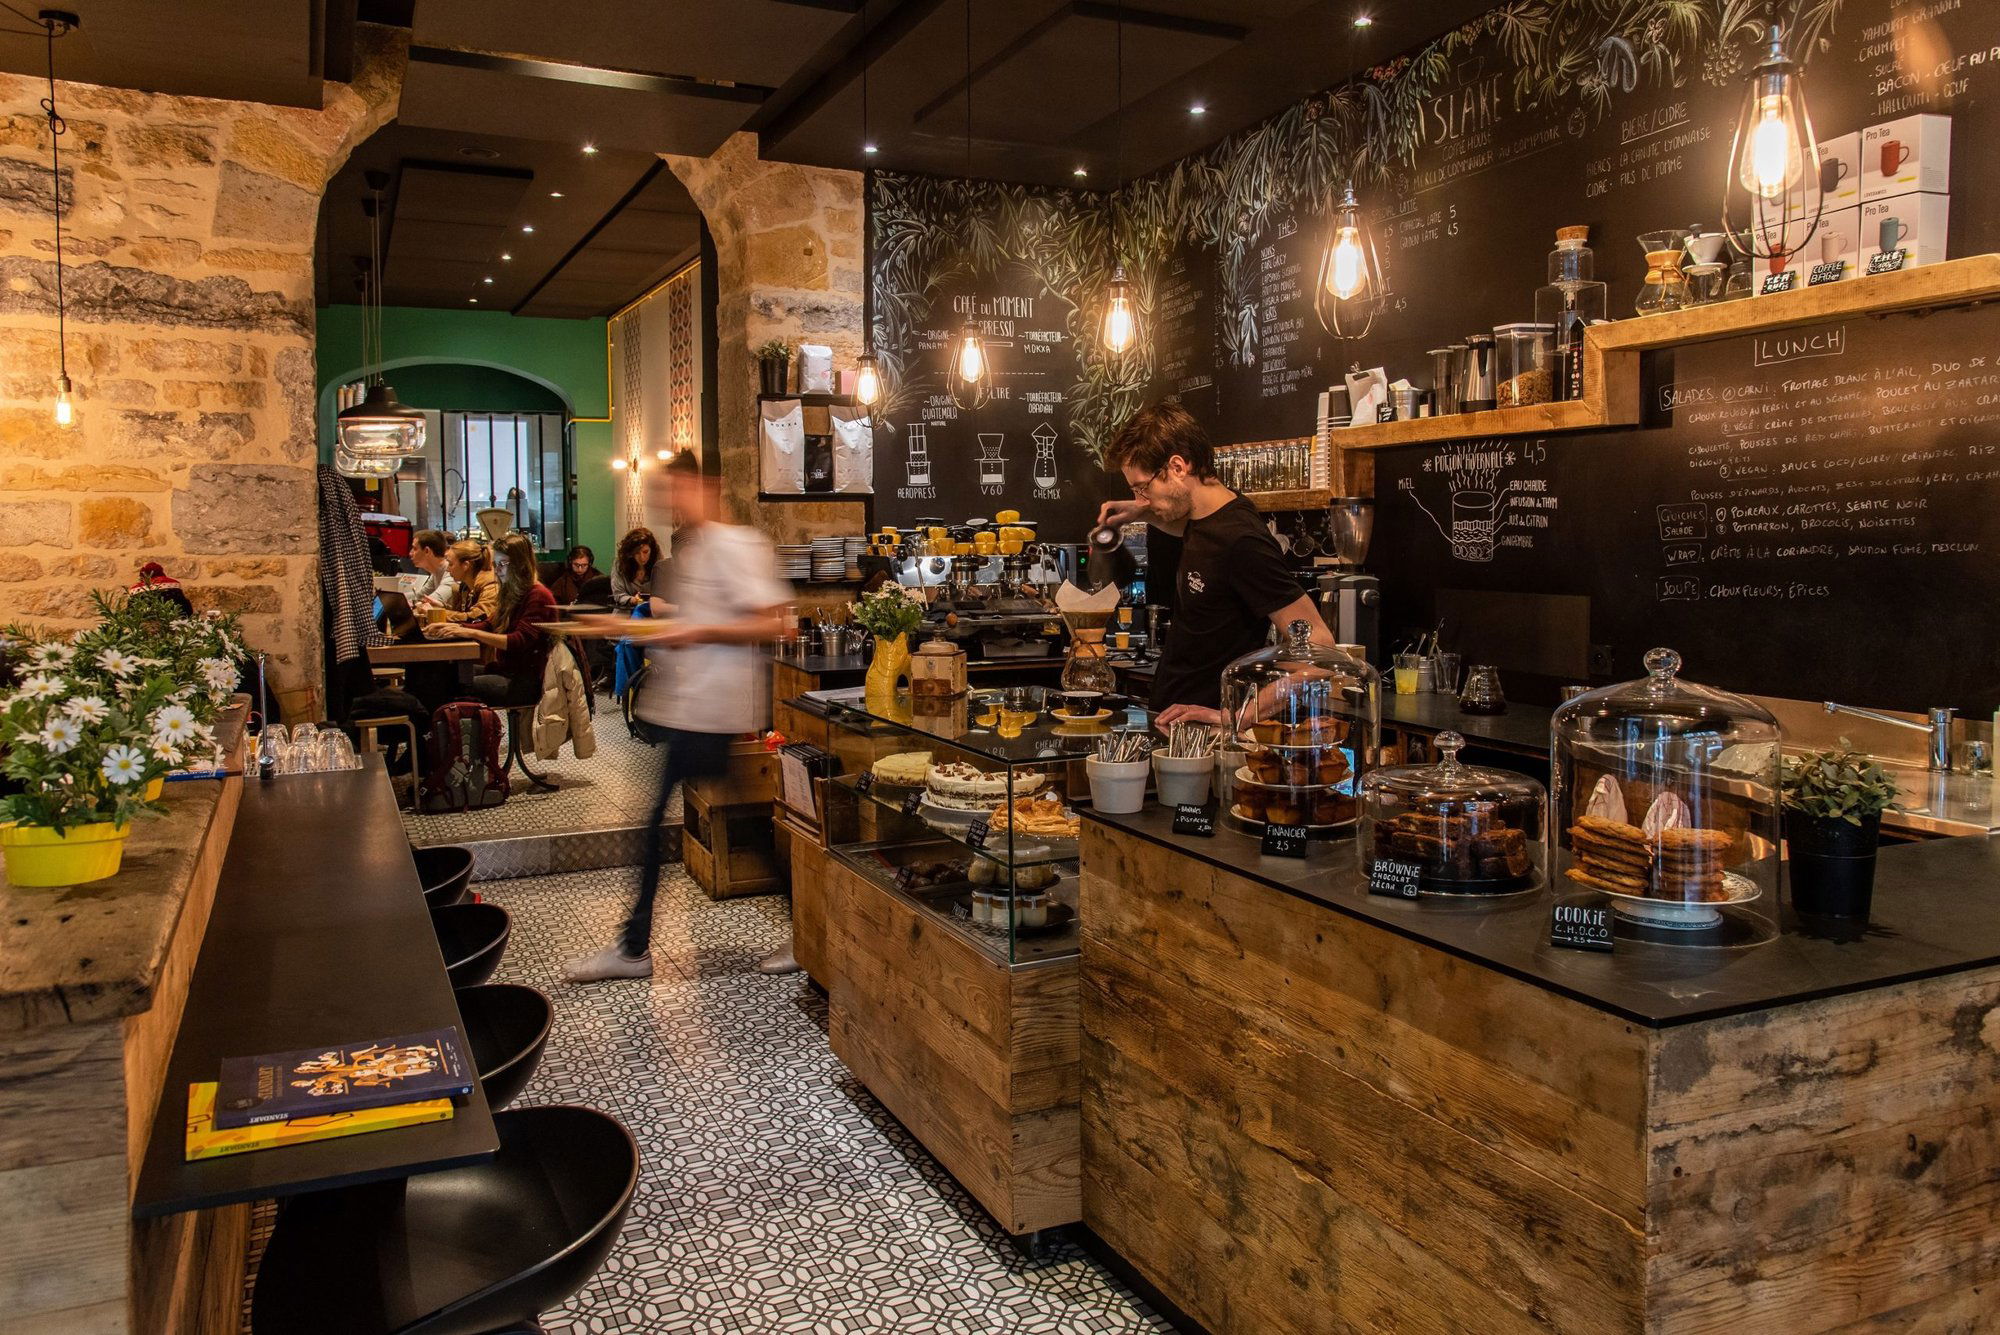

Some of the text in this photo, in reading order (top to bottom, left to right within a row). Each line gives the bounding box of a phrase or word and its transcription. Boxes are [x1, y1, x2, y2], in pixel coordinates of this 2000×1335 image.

[1860, 35, 1908, 62] CRUMPET
[1877, 70, 1920, 96] BACON
[1970, 51, 1986, 66] AU
[1434, 72, 1502, 144] SLAKE
[1878, 91, 1930, 116] HALLOUMI
[1865, 128, 1890, 141] Pro Tea
[1443, 130, 1492, 161] COFFEE HOUSE
[1447, 150, 1494, 179] COMMANDER
[1513, 124, 1561, 154] COMPTOIR
[1620, 152, 1628, 167] LA
[1631, 140, 1661, 163] CANUTE
[1664, 126, 1712, 152] LYONNAISE
[1620, 170, 1636, 187] FILS
[1641, 165, 1651, 182] DE
[1655, 155, 1683, 178] POMME
[1400, 198, 1418, 213] LATTE
[1865, 206, 1889, 217] Pro Tea
[1427, 203, 1457, 226] LATTE 5
[1278, 214, 1298, 237] THÉS
[1422, 228, 1439, 242] LATTE
[1767, 231, 1777, 239] Tea
[1261, 259, 1272, 272] EARL
[1273, 253, 1287, 268] GREY
[1812, 264, 1842, 274] COFFEE
[953, 292, 1034, 318] CAFÉ DU MOMENT
[927, 328, 1062, 343] ORIGINE TORRÉFACTEUR
[978, 320, 1014, 337] SPRESSO
[1024, 345, 1050, 353] MOKXA
[1762, 330, 1839, 359] LUNCH
[1781, 378, 1828, 392] FROMAGE
[1834, 373, 1868, 385] BLANC
[1874, 368, 1881, 380] À
[1931, 362, 1960, 375] DUO
[1969, 357, 1986, 367] DE
[1026, 391, 1062, 403] TORRÉFACTEUR
[1689, 412, 1716, 423] CHOUX
[1795, 400, 1806, 409] ET
[1810, 397, 1822, 406] AU
[1876, 385, 1919, 398] POULET
[1924, 382, 1940, 391] AU
[922, 407, 957, 420] GUATEMALA
[1765, 419, 1793, 430] CRÈME
[1800, 417, 1813, 426] DE
[1740, 438, 1778, 450] POUSSES
[1785, 435, 1798, 444] DE
[1805, 433, 1826, 442] RED
[1940, 418, 1956, 427] ET
[1435, 454, 1462, 473] POTION
[1524, 440, 1546, 465] 4,5
[1781, 461, 1817, 473] SAUCE
[1969, 445, 1996, 456] RIZ
[897, 485, 1061, 500] AEROPRESS V60 CHEMEX
[1510, 480, 1547, 491] EAU CHAUDE
[1690, 489, 1723, 501] POUSSES
[1836, 480, 1865, 490] ZEST
[1846, 499, 1889, 513] SÉSAME
[1664, 525, 1694, 538] SALADE
[1859, 516, 1916, 529] NOISETTES
[1667, 550, 1697, 561] WRAP
[1711, 545, 1741, 560] CRÈME
[1663, 580, 1830, 599] SOUPE ÉPICES
[1180, 816, 1209, 824] PISTACHE
[1267, 825, 1307, 839] FINANCIER
[1276, 841, 1289, 851] 2,5
[1371, 880, 1395, 890] PÉCAN
[1372, 872, 1411, 883] CHOCOLAT
[249, 1113, 289, 1124] STANDART
[220, 1142, 259, 1153] STANDART
